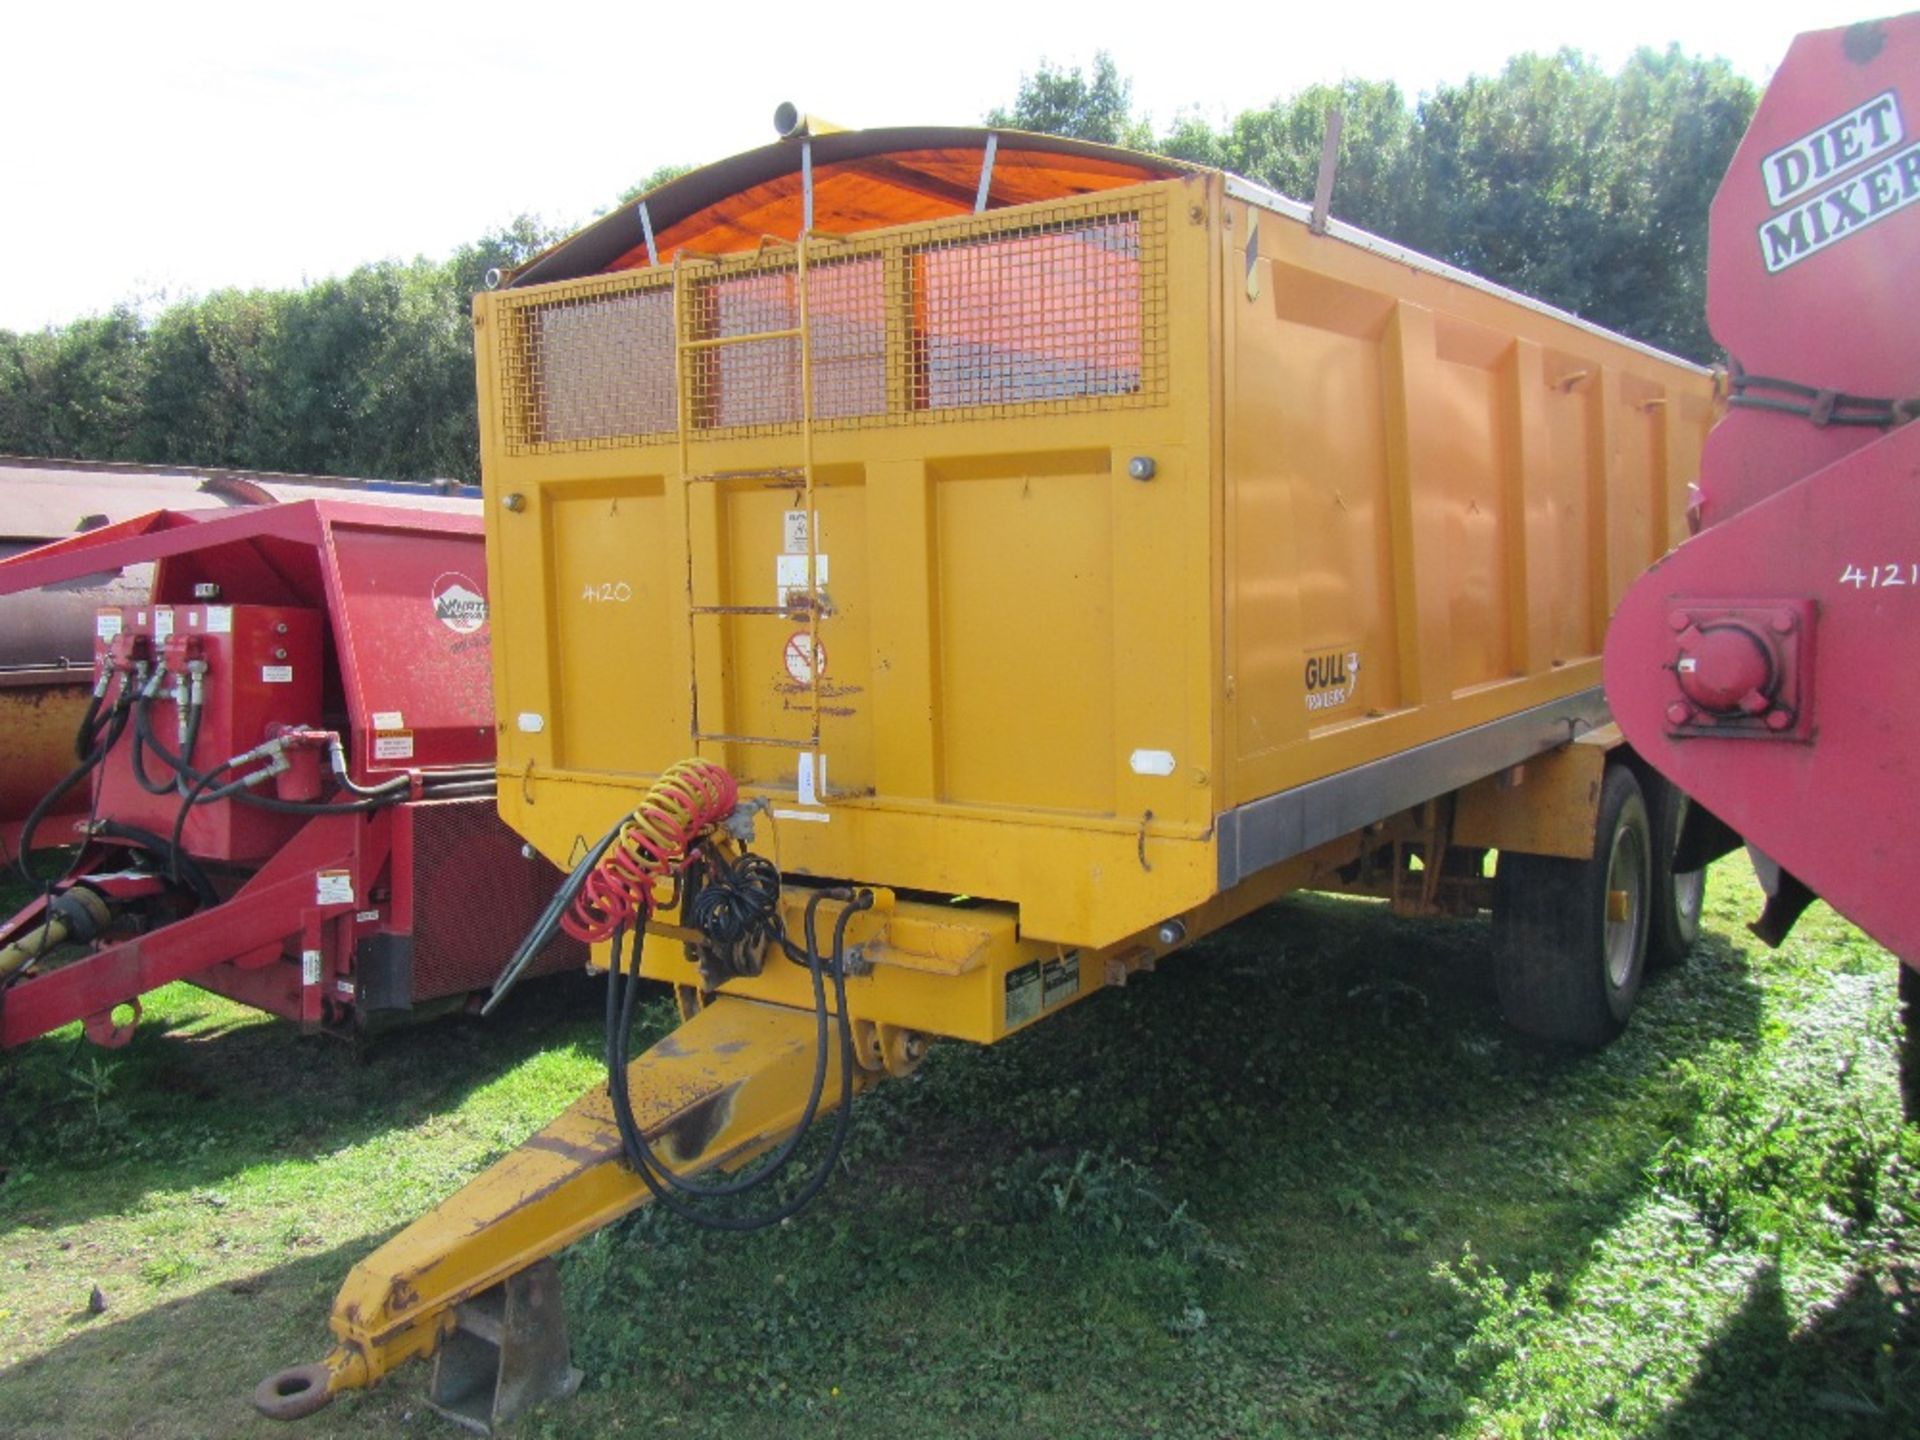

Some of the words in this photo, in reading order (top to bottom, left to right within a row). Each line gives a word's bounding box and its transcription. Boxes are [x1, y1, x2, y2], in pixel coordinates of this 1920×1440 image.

[1773, 96, 1892, 200] DIET
[1839, 563, 1918, 589] 4121
[581, 581, 632, 604] 4120
[1305, 653, 1346, 690] GULL
